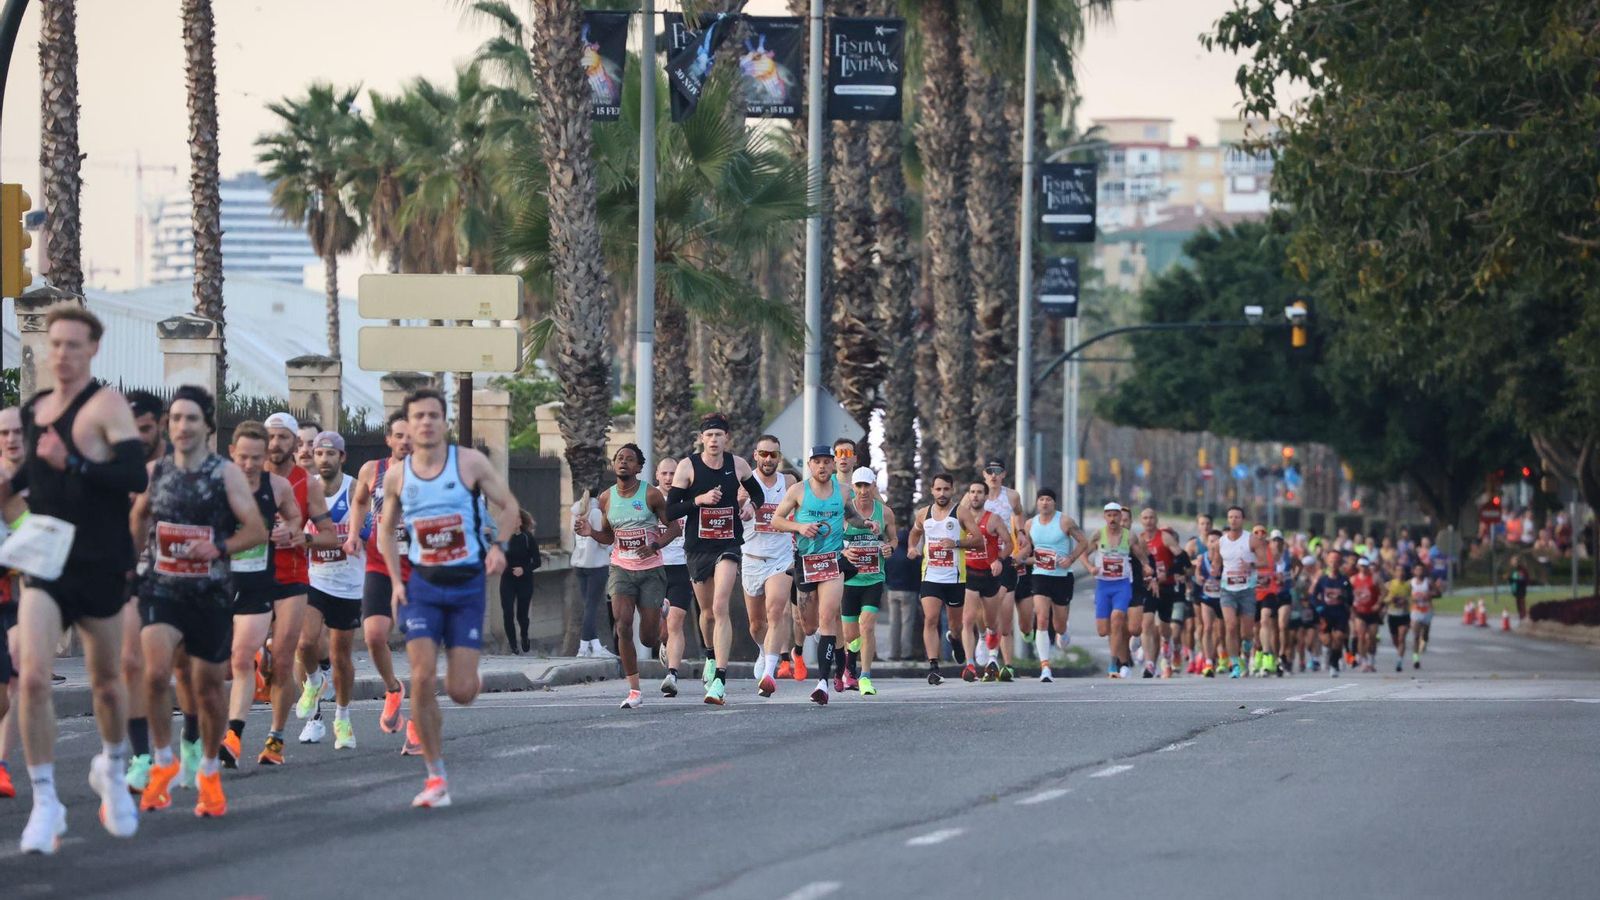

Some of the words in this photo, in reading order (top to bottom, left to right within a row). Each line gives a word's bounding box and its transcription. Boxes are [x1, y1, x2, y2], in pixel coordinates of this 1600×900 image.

[836, 34, 889, 56] FESTIVAL
[841, 53, 898, 77] LINTERNAS
[596, 106, 605, 115] 15
[770, 105, 778, 113] 15
[779, 105, 794, 114] FEB
[709, 518, 726, 526] 4922
[622, 539, 641, 547] 17390
